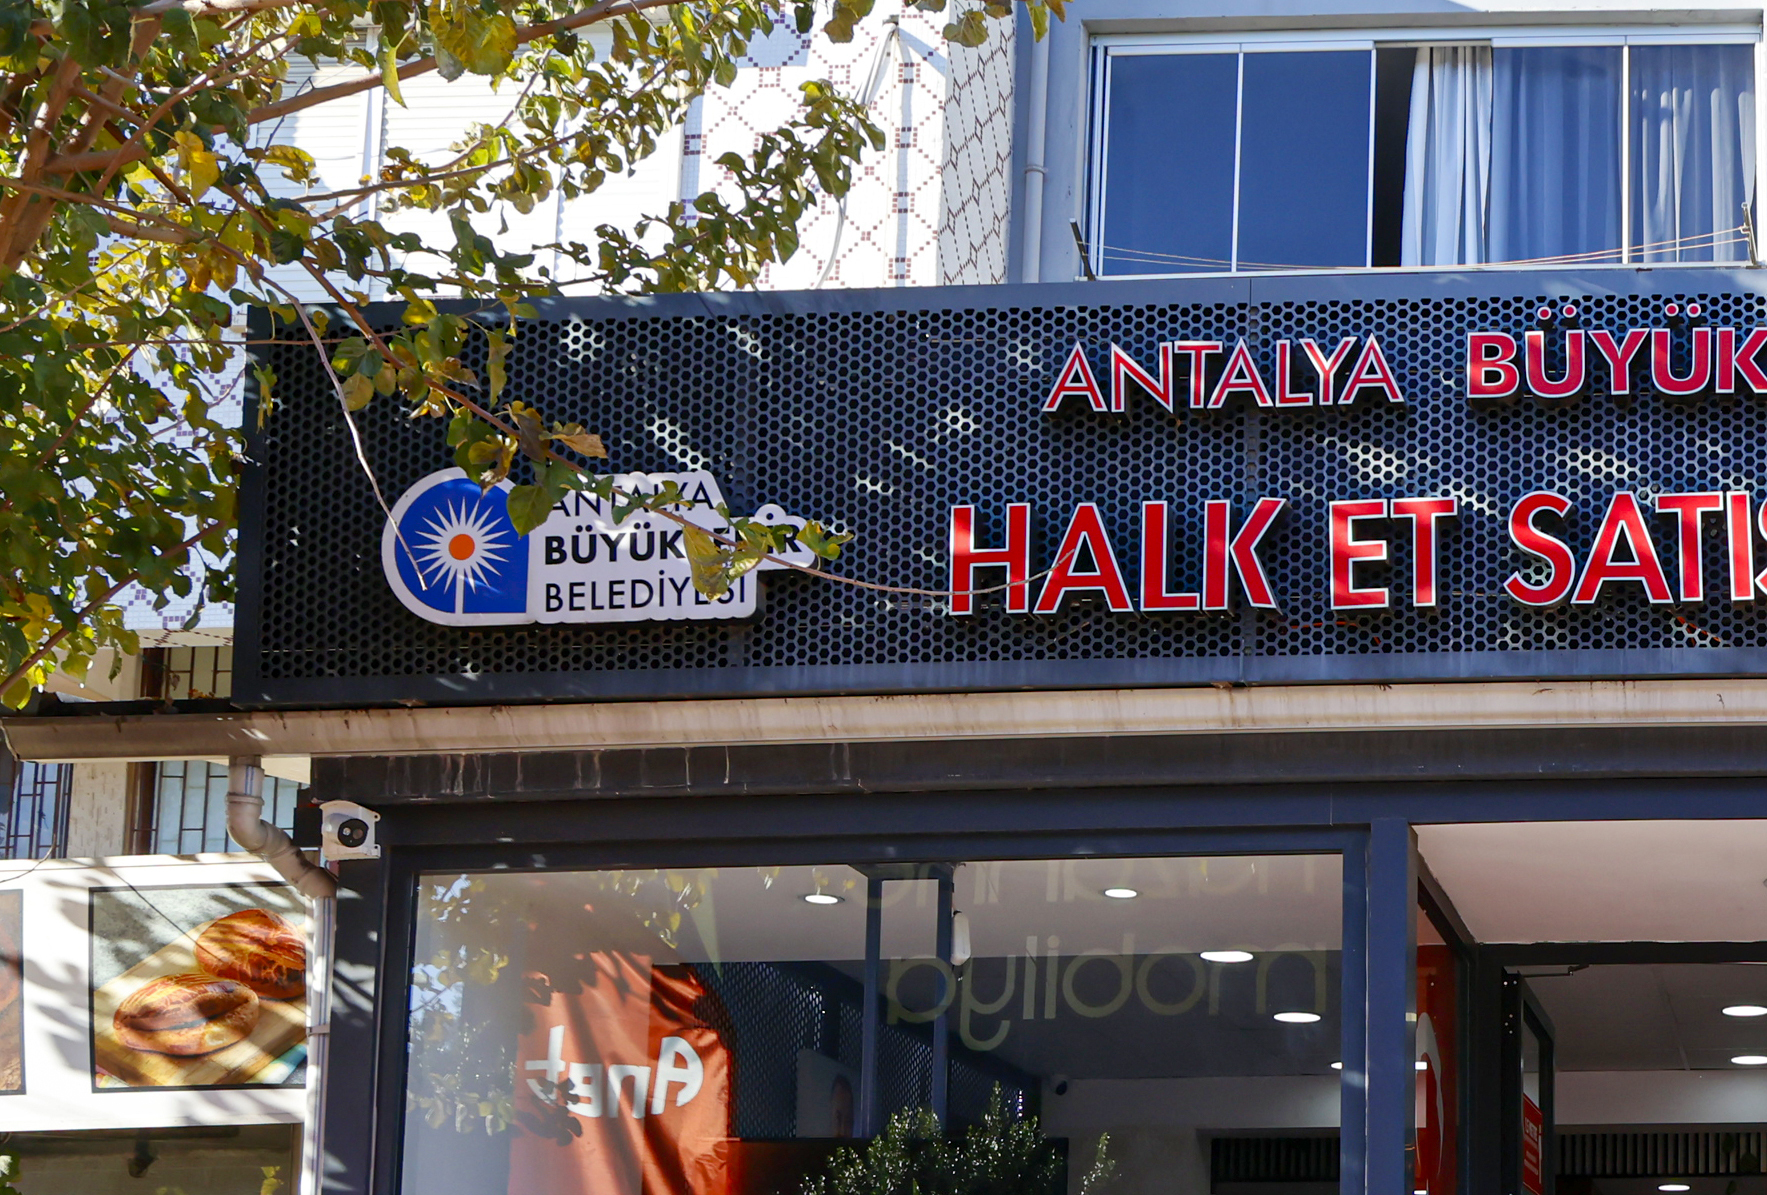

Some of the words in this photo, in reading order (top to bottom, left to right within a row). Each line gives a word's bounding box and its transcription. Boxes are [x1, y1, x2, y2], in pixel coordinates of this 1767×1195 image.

[1041, 332, 1406, 414] ANTALYA
[946, 497, 1288, 616] HALK
[1329, 496, 1458, 611] ET
